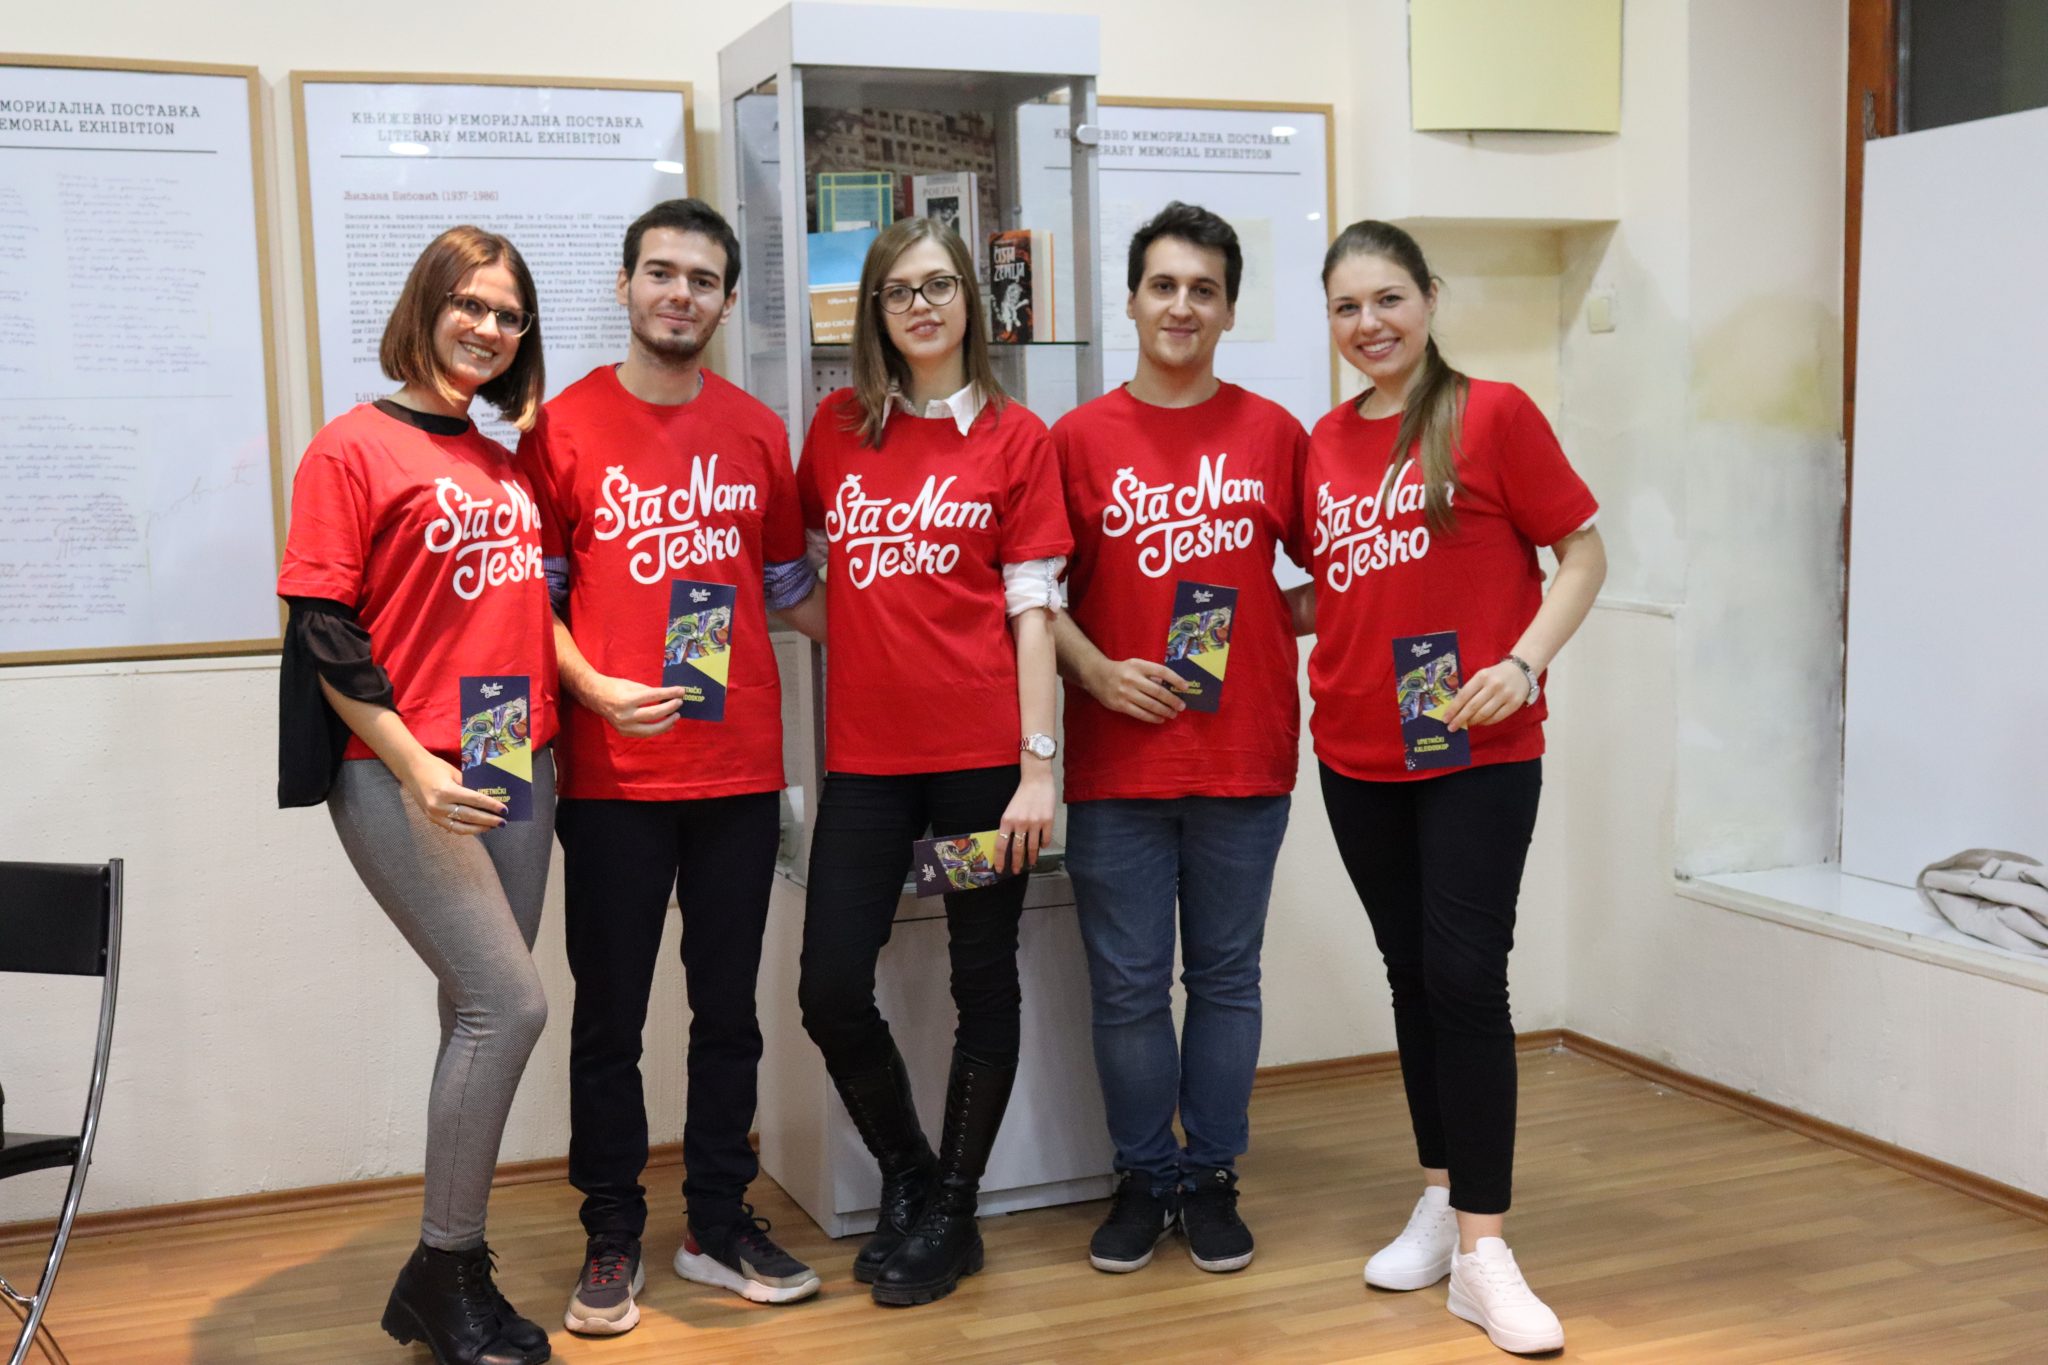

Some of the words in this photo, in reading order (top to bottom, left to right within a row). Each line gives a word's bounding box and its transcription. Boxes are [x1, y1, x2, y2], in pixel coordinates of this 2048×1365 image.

[0, 99, 105, 116] МОРИЈАЛНА
[111, 103, 200, 118] ПОСТАВКА
[0, 117, 73, 133] EMORIAL
[79, 120, 175, 135] EXHIBITION
[351, 111, 442, 125] КЊИЖЕВНО
[448, 113, 560, 127] МЕМОРИЈАЛНА
[565, 116, 644, 128] ПОСТАВКА
[377, 129, 450, 142] LITERARY
[457, 131, 533, 143] MEMORIAL
[537, 131, 621, 144] EXHIBITION
[1132, 130, 1223, 144] МЕМОРИЈАЛНА
[1227, 132, 1291, 145] ПОСТАВКА
[1098, 144, 1134, 157] ERARY
[1138, 146, 1200, 158] MEMORIAL
[1204, 147, 1272, 160] EXHIBITION
[922, 184, 961, 197] POEZIJA
[993, 261, 1025, 283] ZEMLJA
[425, 476, 493, 553] Šta
[494, 479, 542, 537] Na
[594, 464, 668, 541] Šta
[668, 453, 757, 522] Nam
[825, 473, 892, 543] Šta
[886, 474, 993, 533] Nam
[1102, 466, 1175, 538] Šta
[1174, 453, 1266, 517] Nam
[453, 535, 544, 600] Tešk
[626, 519, 741, 585] Teško
[845, 532, 960, 590] Teško
[1135, 513, 1254, 578] Teško
[1327, 524, 1430, 593] Teško
